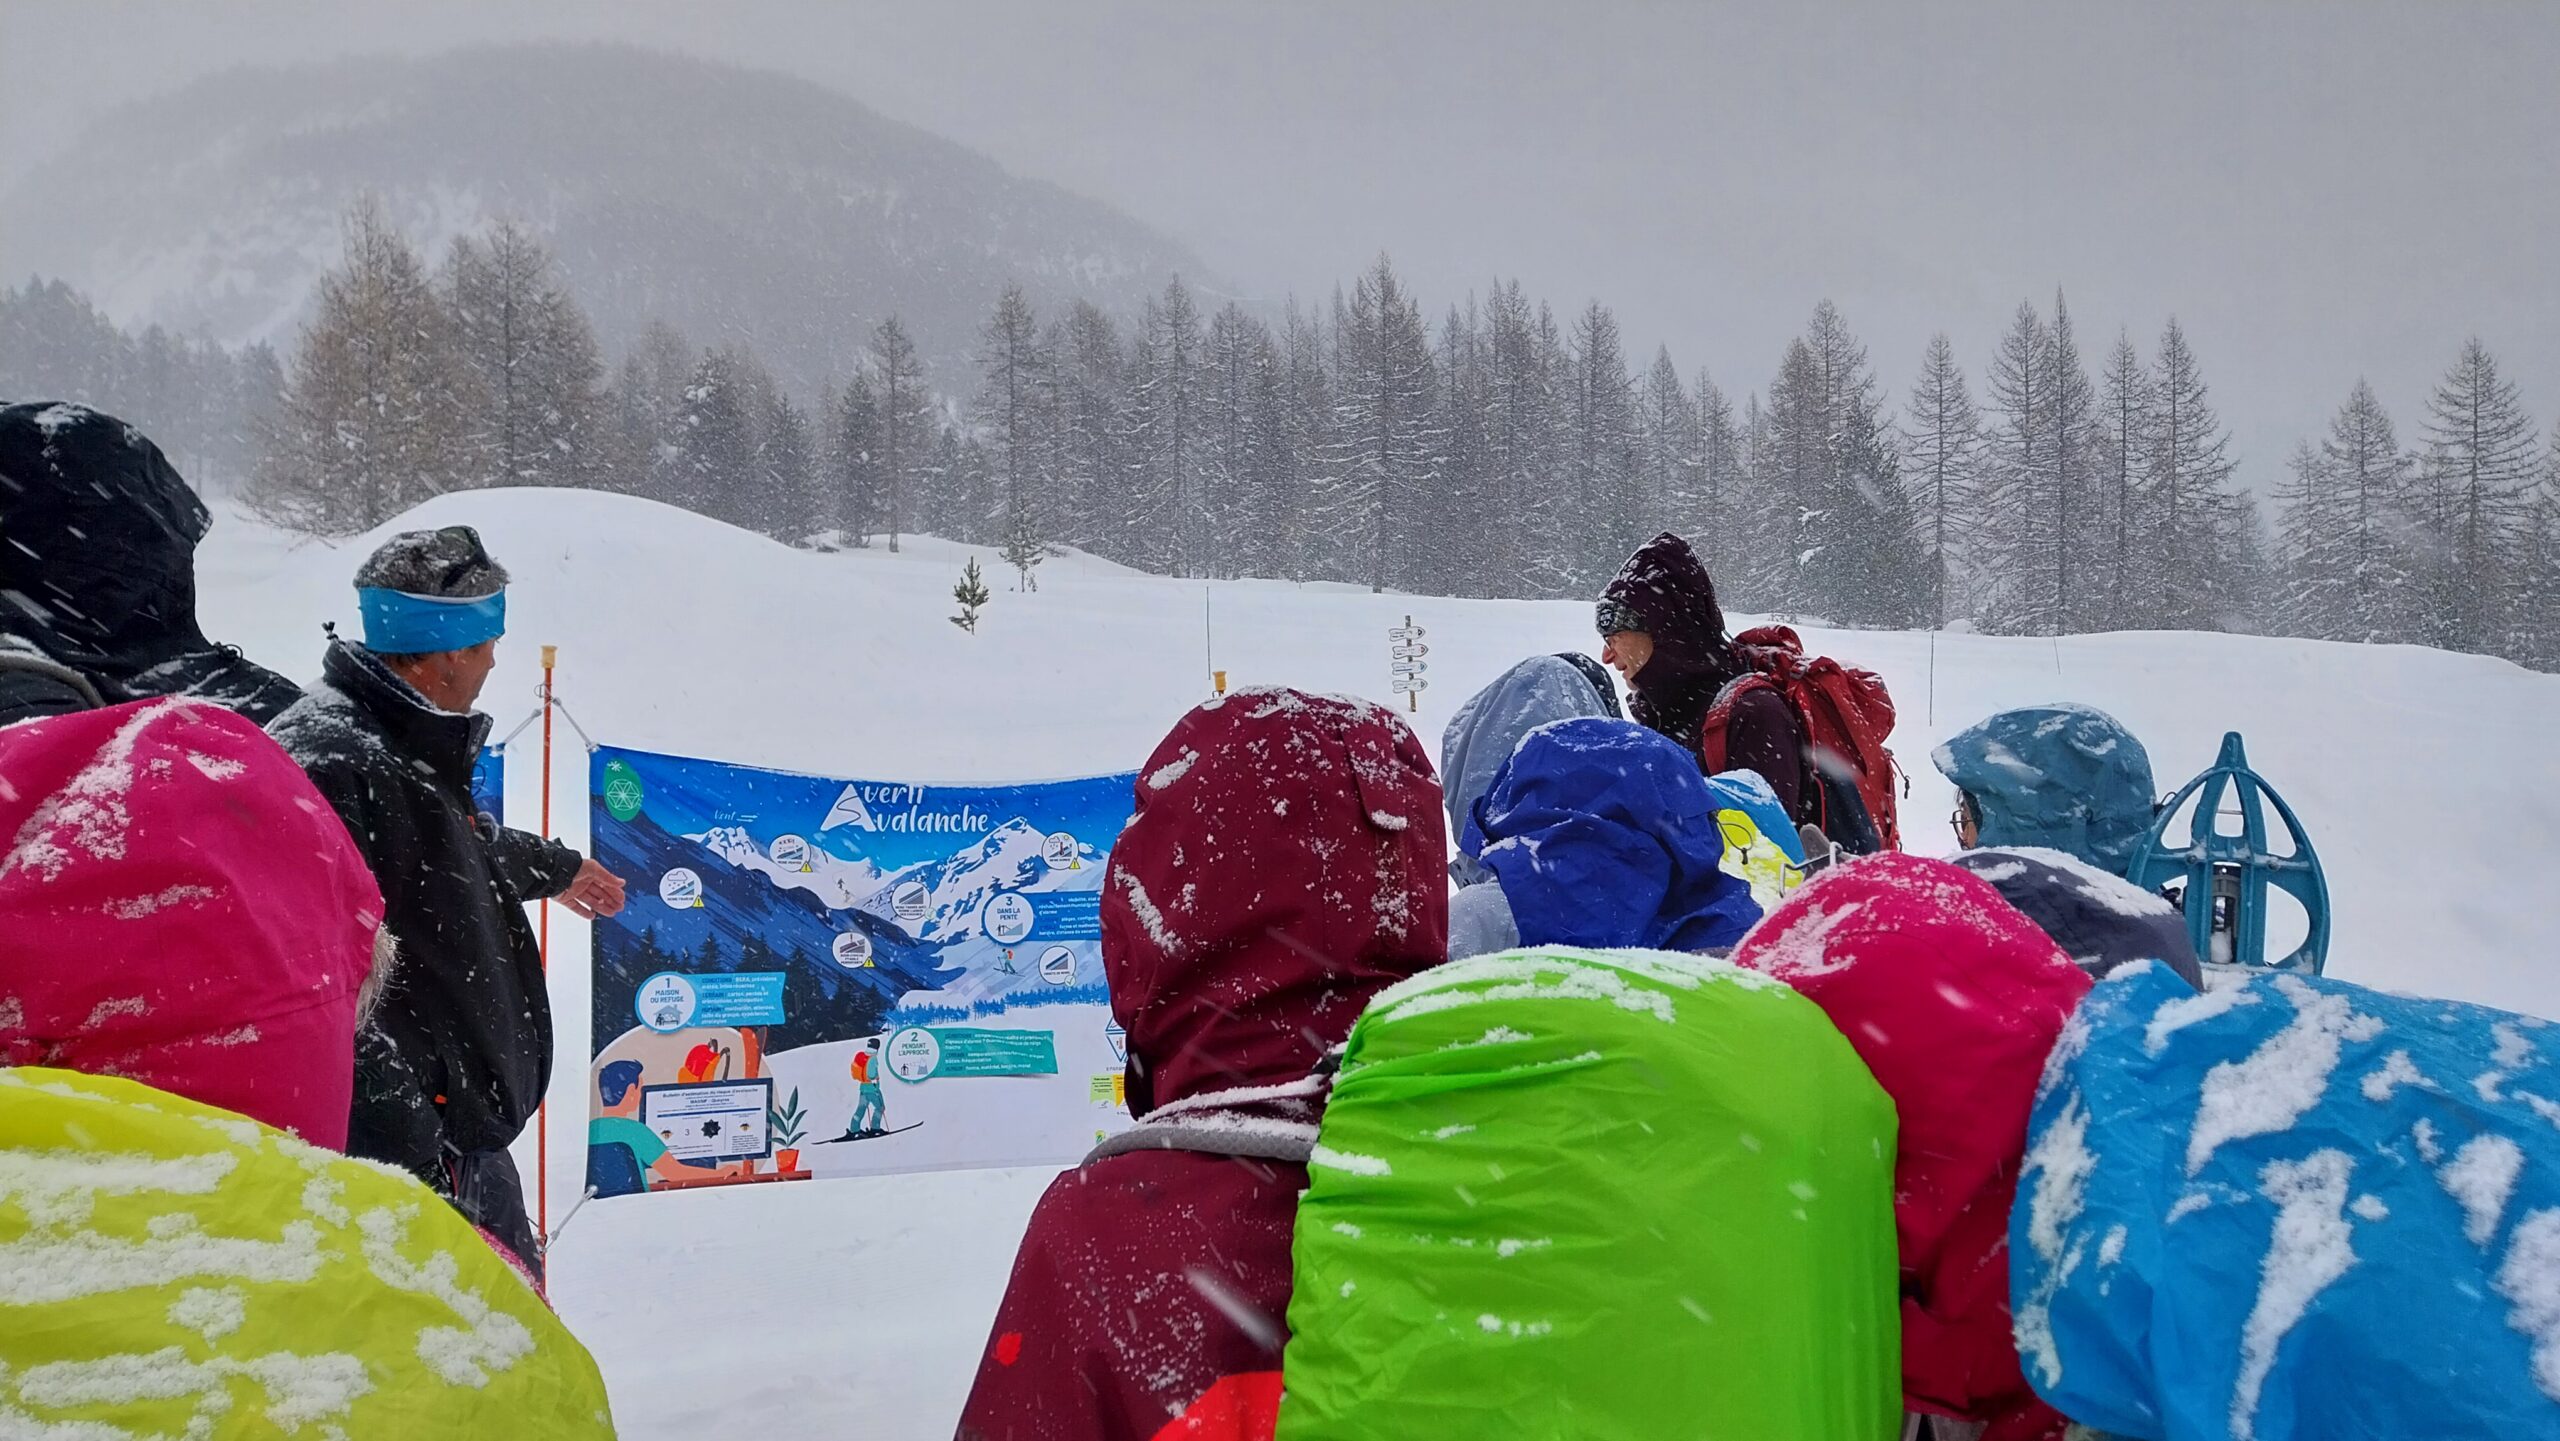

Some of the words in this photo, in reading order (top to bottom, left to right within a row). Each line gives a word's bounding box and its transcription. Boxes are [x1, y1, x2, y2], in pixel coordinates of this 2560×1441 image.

[1005, 896, 1013, 906] 3
[665, 977, 670, 988] 1
[660, 995, 685, 1003] REFUGE
[911, 1032, 918, 1042] 2
[684, 1128, 690, 1136] 3
